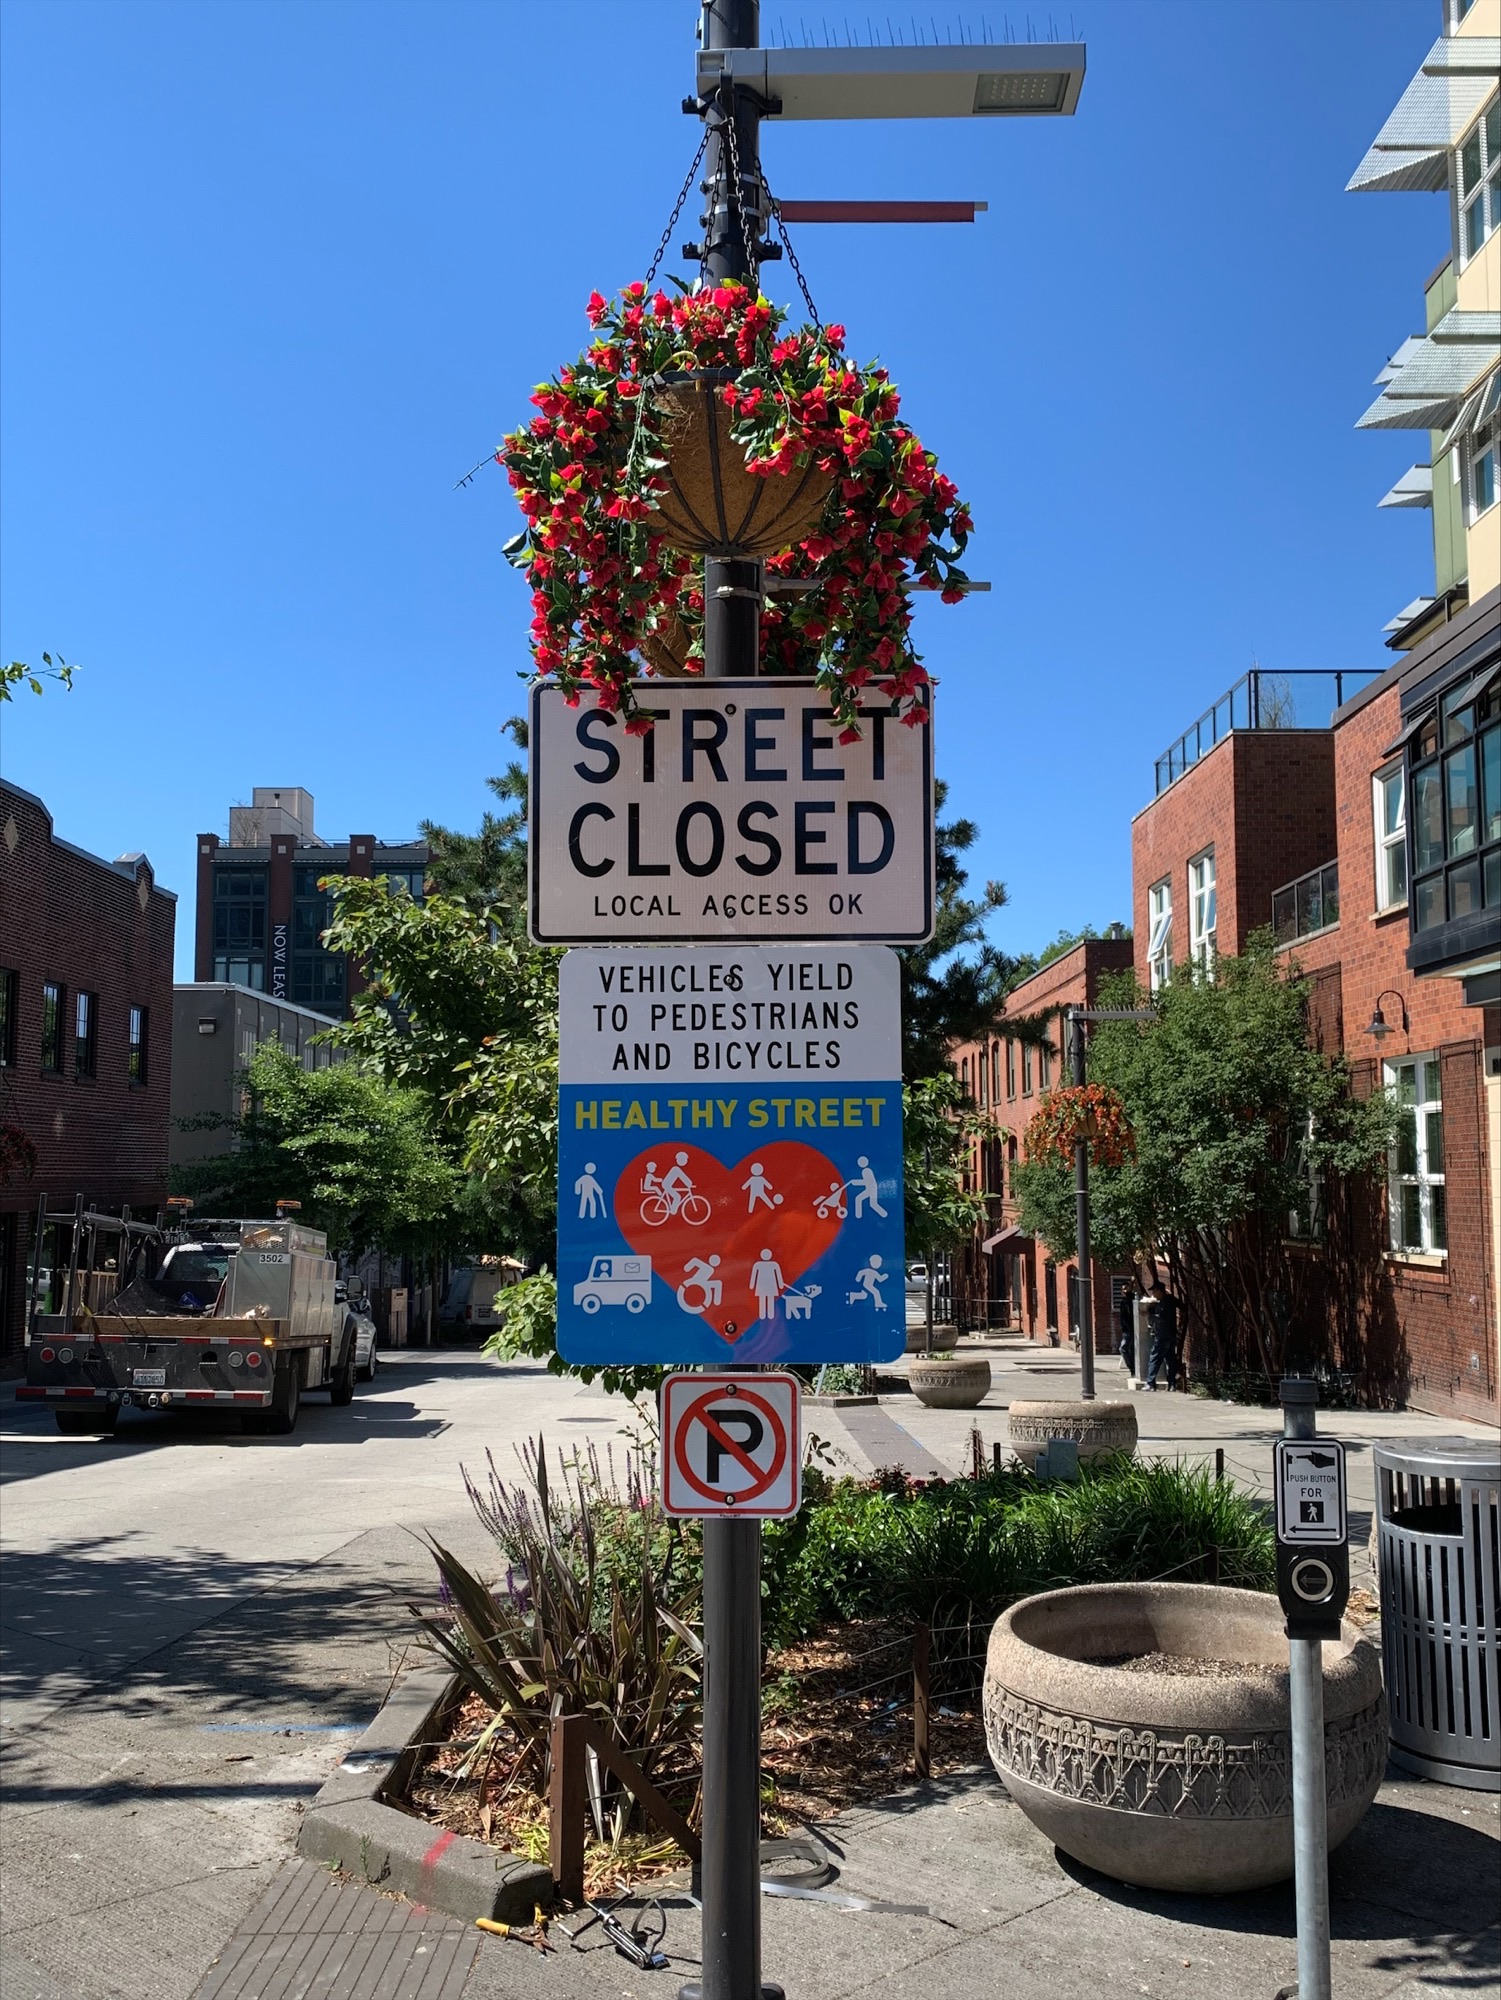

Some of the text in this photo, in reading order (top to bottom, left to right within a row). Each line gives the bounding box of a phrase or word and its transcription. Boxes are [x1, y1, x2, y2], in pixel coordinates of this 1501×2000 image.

[574, 707, 900, 784] STREET
[568, 800, 895, 878] CLOSED
[594, 893, 863, 917] LOCAL ACCESS OK
[272, 925, 286, 1000] NOW LEAS
[598, 963, 854, 993] VEHICLES YIELD
[593, 1001, 860, 1032] TO PEDESTRIANS
[612, 1040, 841, 1071] AND BICYCLES
[575, 1098, 887, 1130] HEALTHY STREET
[260, 1254, 283, 1263] 3502
[706, 1409, 764, 1484] P
[1290, 1474, 1337, 1483] PUSH BUTTON
[1301, 1487, 1322, 1498] FOR
